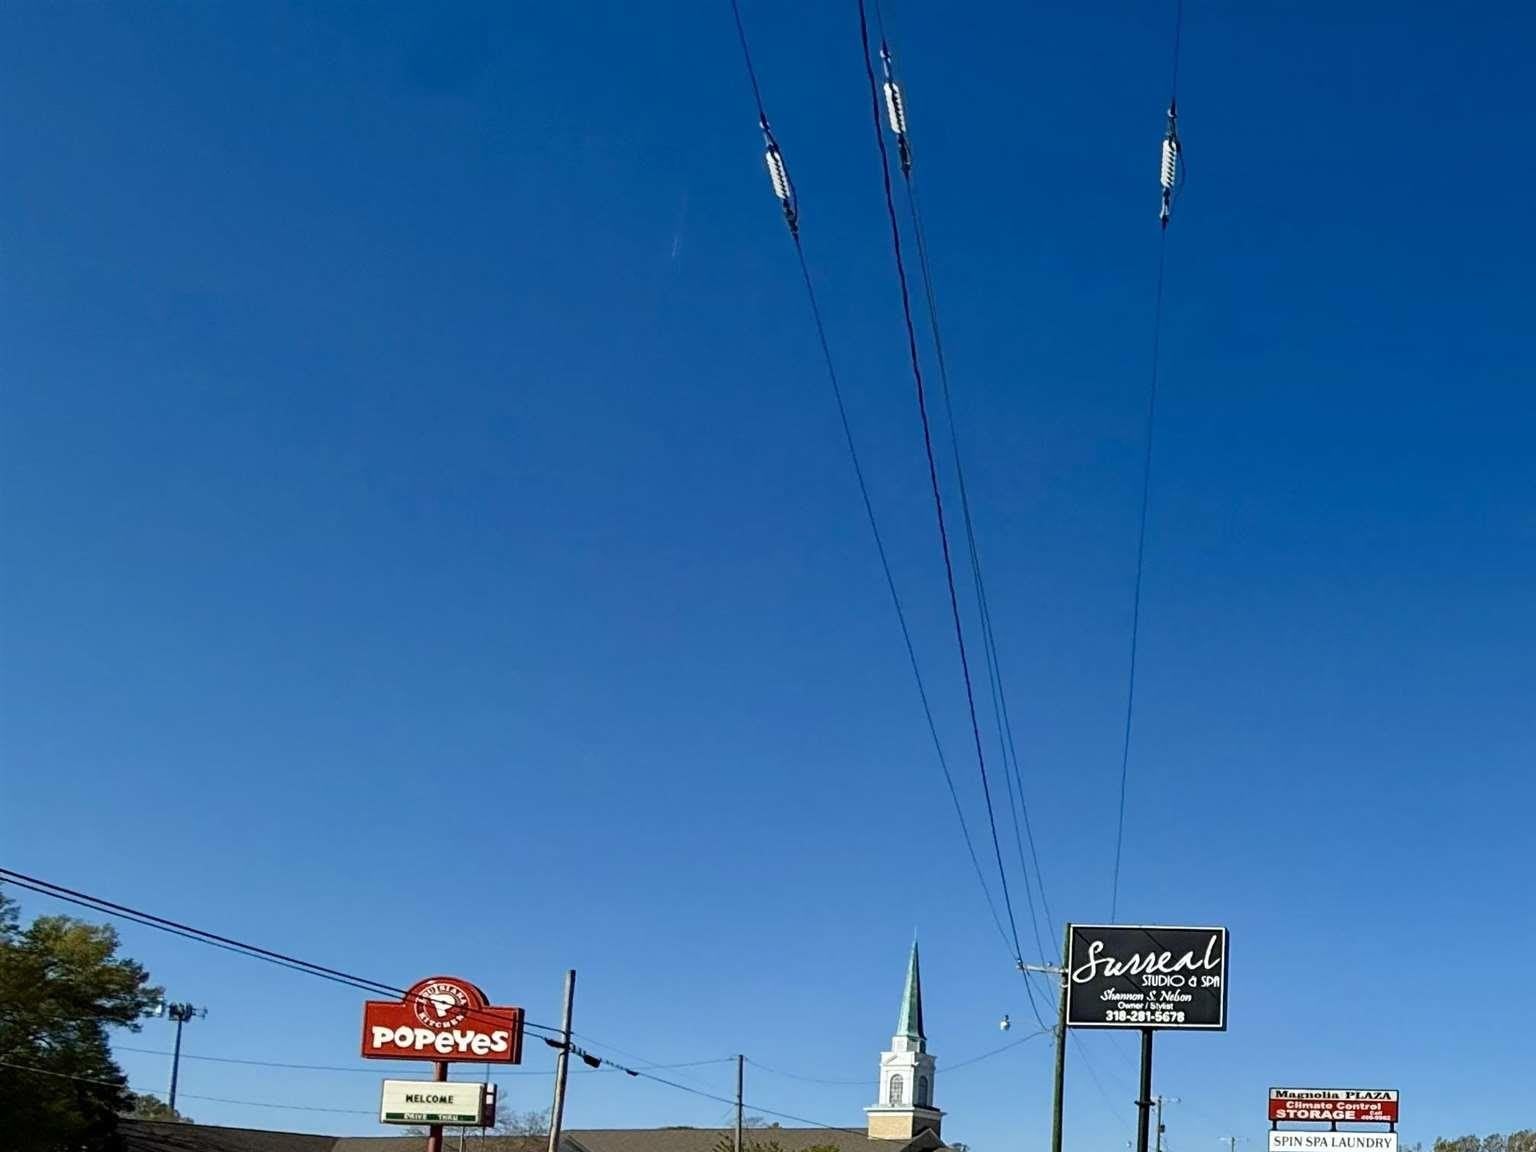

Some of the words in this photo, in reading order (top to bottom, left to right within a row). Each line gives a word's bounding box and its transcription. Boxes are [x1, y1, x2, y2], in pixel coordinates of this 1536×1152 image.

[1072, 935, 1220, 983] Surreal
[1142, 974, 1184, 987] STUDIO
[1201, 976, 1220, 988] SPA
[1100, 988, 1144, 1001] Shannon
[1160, 988, 1192, 1002] Nelson
[1118, 1002, 1144, 1010] Owner
[1150, 1002, 1174, 1010] Stylist
[418, 1012, 464, 1028] KITCHEN
[1106, 1010, 1185, 1022] 318-281-5678
[406, 1094, 454, 1104] WELCOME
[1276, 1090, 1340, 1100] Magnolia
[1346, 1091, 1392, 1100] PLAZA
[1286, 1101, 1332, 1110] Climate
[1336, 1102, 1381, 1110] Control
[1276, 1109, 1356, 1120] STORAGE
[1274, 1136, 1302, 1147] SPIN
[1305, 1136, 1328, 1147] SPA
[1331, 1137, 1392, 1148] LAUNDRY
